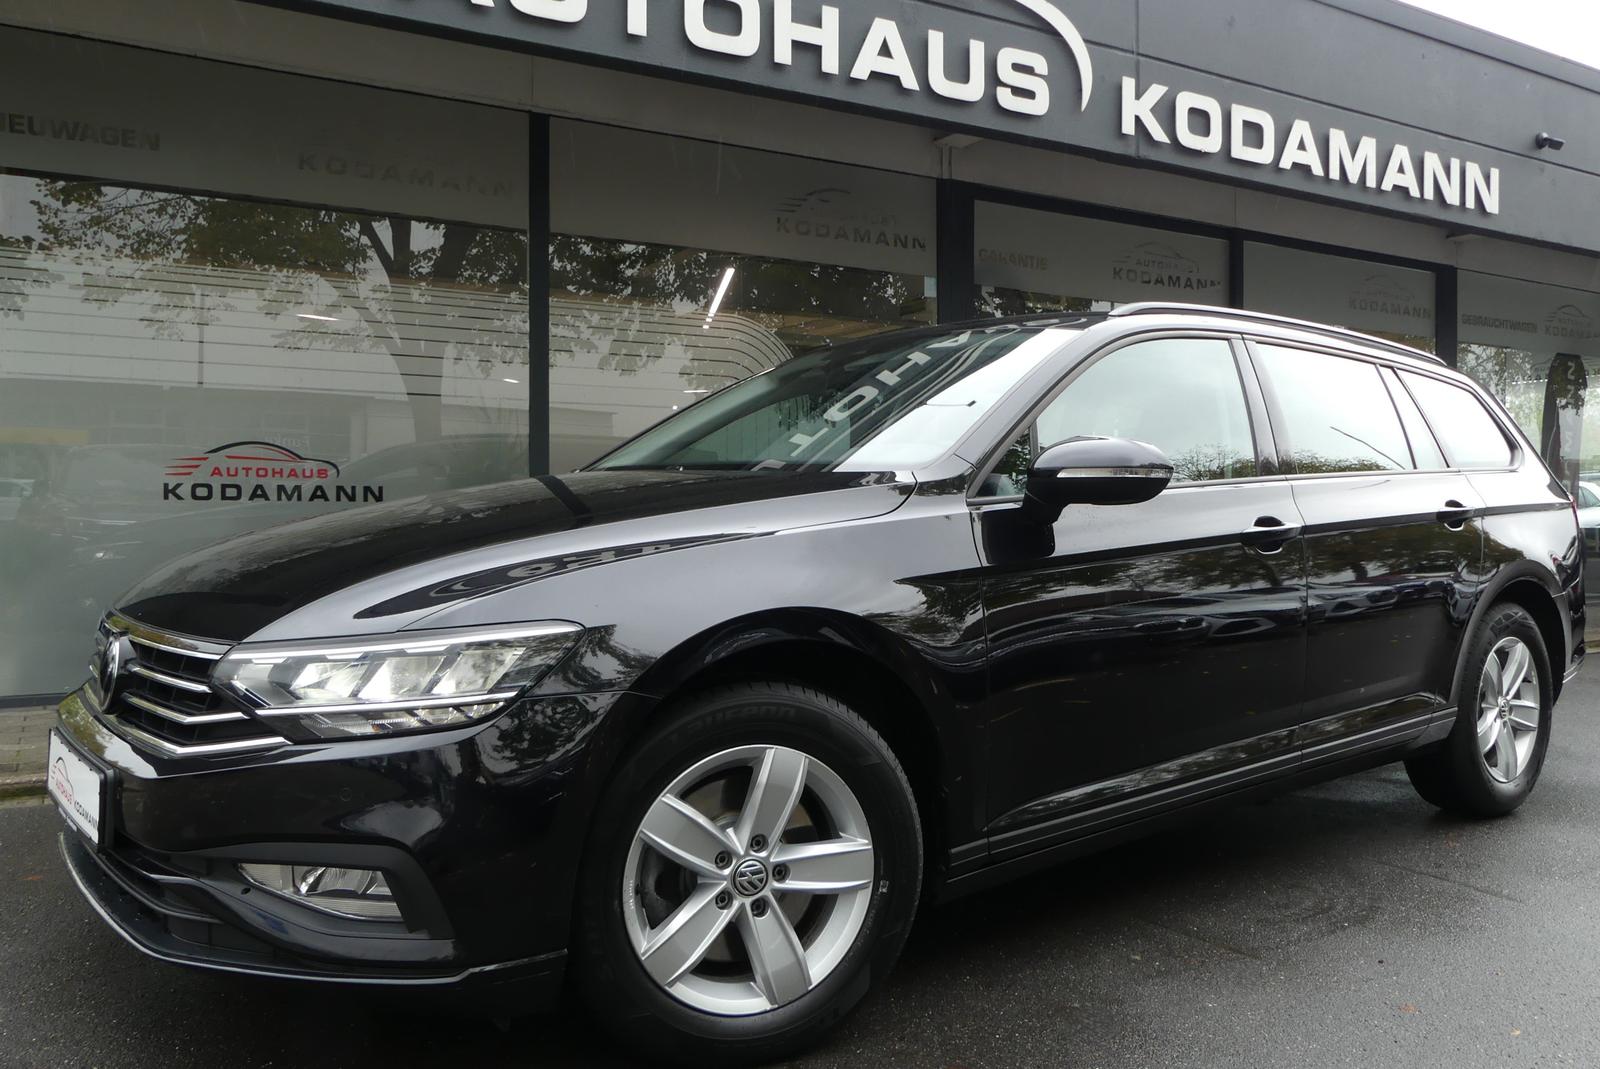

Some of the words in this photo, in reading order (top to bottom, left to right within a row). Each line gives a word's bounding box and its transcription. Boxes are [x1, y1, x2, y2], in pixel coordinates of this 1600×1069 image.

[1120, 76, 1500, 216] KODAMANN
[776, 216, 927, 250] KODAMANN
[211, 466, 330, 480] AUTOHAUS
[162, 483, 384, 503] KODAMANN
